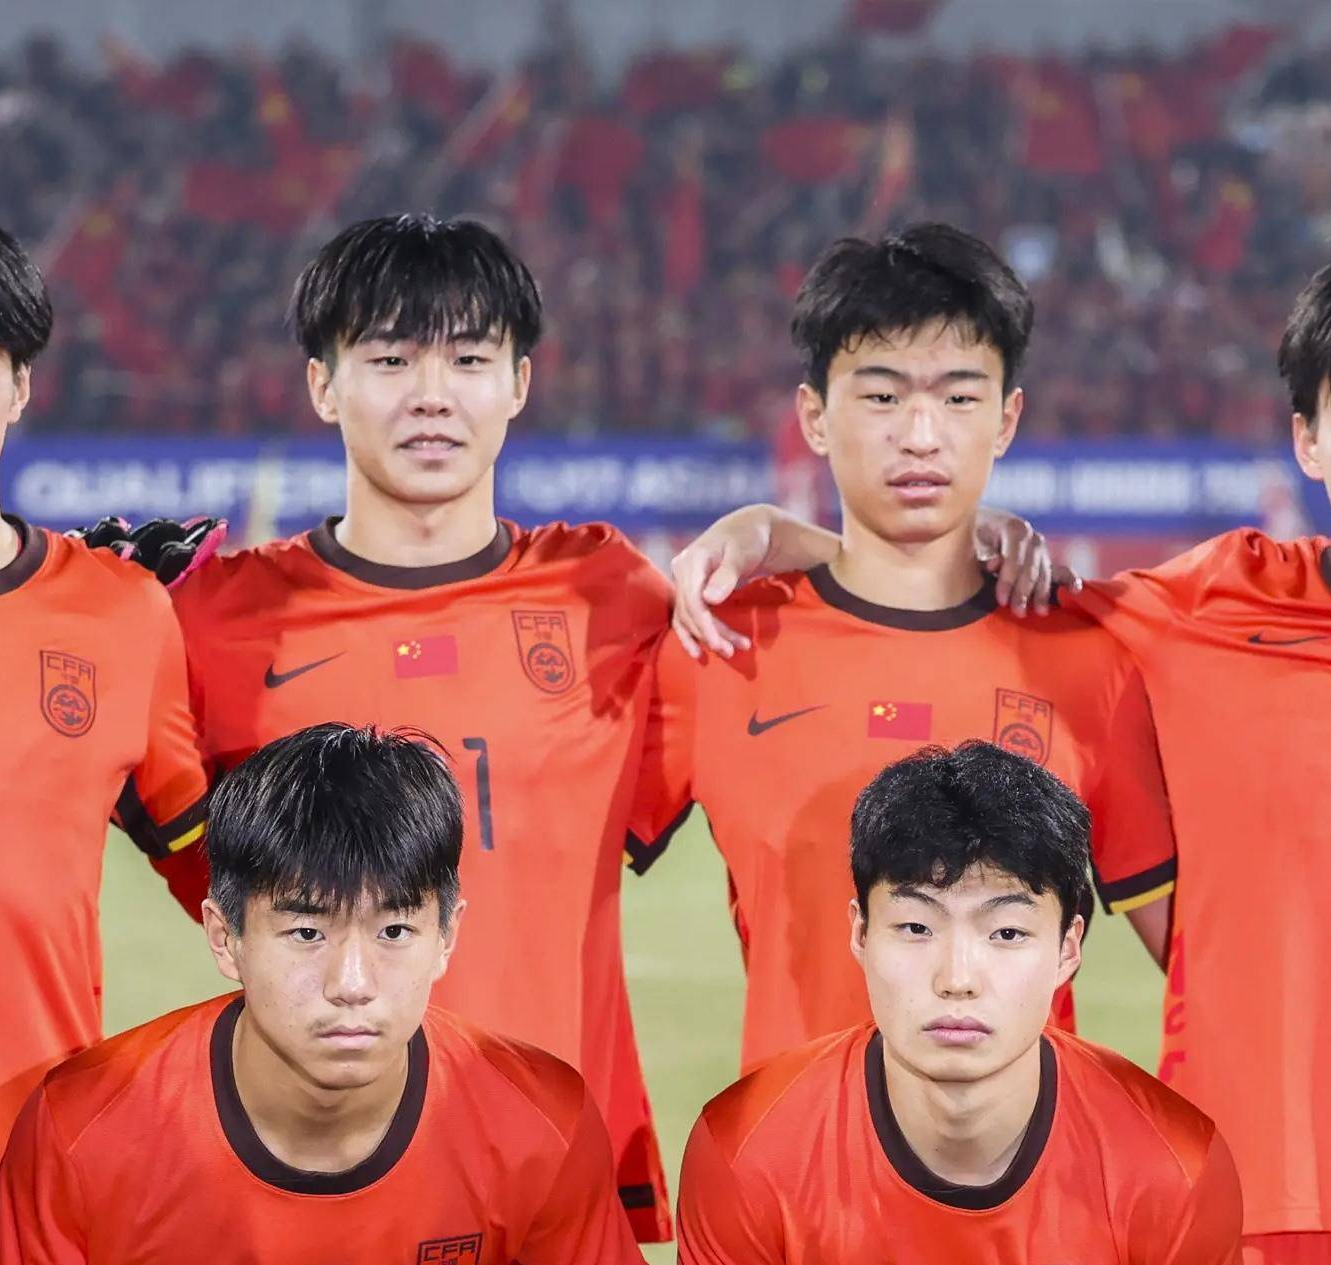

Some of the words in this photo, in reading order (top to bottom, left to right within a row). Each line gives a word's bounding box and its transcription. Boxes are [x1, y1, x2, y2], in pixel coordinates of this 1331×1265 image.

[519, 616, 563, 631] CFA
[46, 655, 91, 679] CFA
[1002, 694, 1047, 718] CFA
[424, 1240, 475, 1262] CFA
